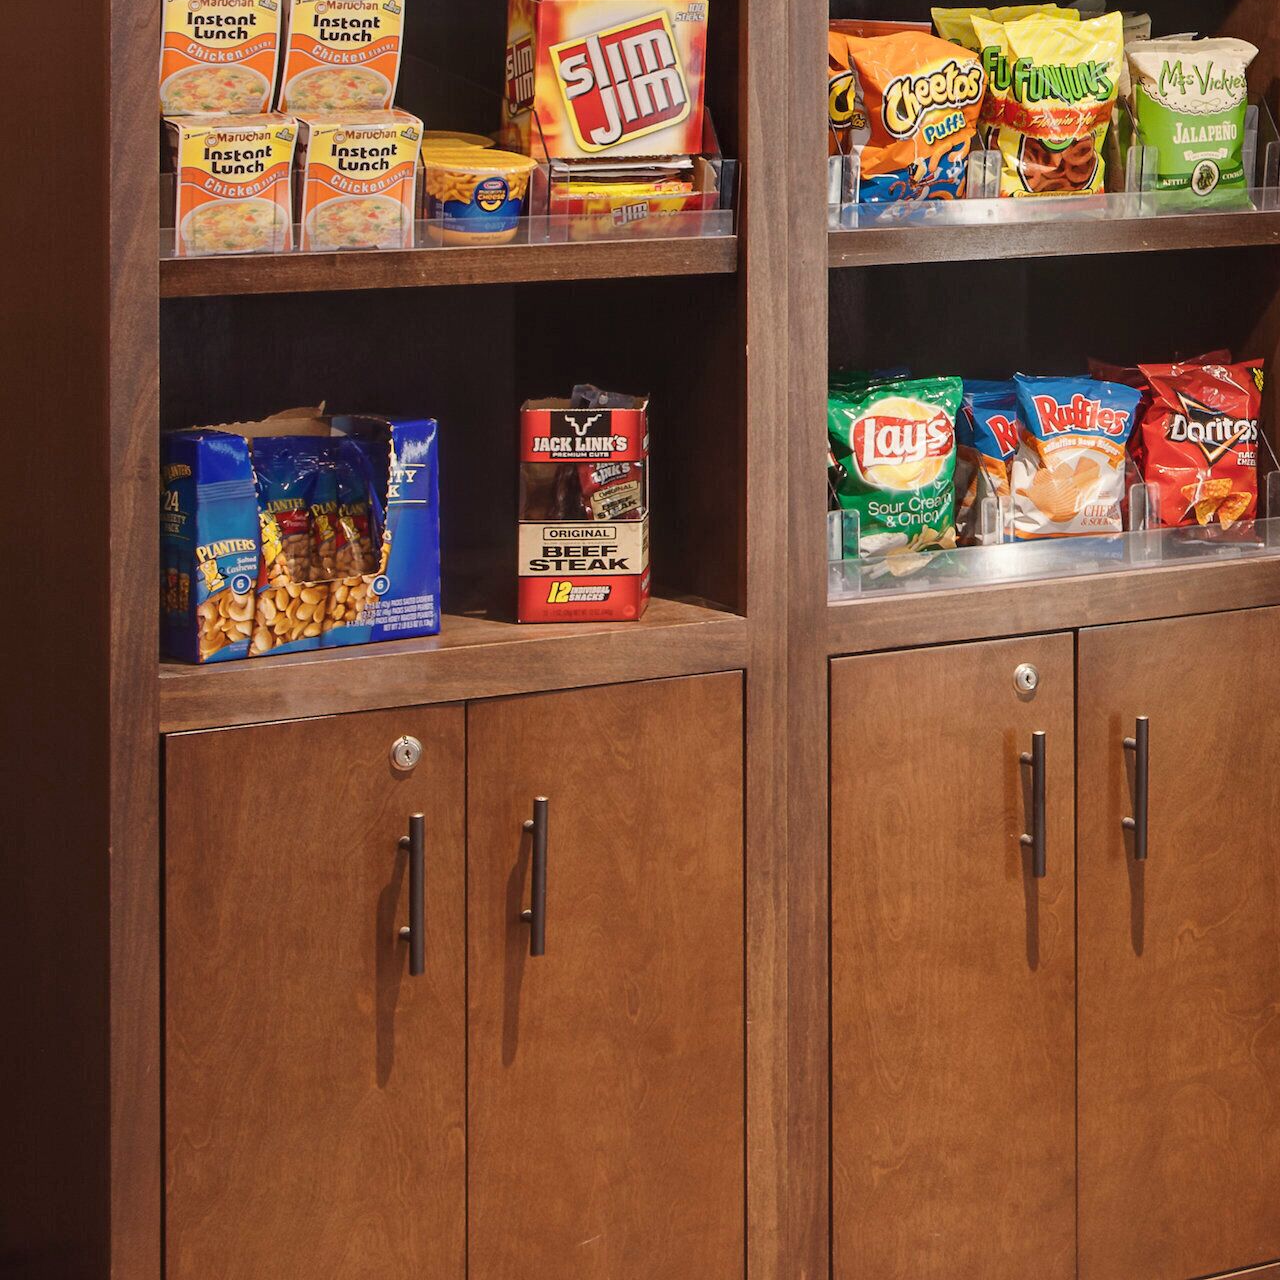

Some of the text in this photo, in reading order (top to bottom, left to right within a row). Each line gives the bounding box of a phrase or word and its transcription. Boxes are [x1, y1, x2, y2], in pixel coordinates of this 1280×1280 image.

[326, 0, 379, 11] Maruchan
[187, 11, 257, 27] Instant
[313, 15, 381, 30] Instant
[675, 11, 705, 22] Sticks
[194, 26, 248, 40] Lunch
[320, 29, 372, 42] Lunch
[186, 40, 243, 63] Chicken
[312, 44, 366, 64] Chicken
[1192, 60, 1247, 98] Vickie's
[884, 61, 983, 135] Cheetos
[345, 130, 397, 140] Maruchan
[923, 111, 966, 144] Puffs
[1173, 120, 1237, 145] JALAPEÑO
[217, 131, 271, 143] Maruchan
[204, 145, 272, 161] Instant
[331, 144, 398, 158] Instant
[211, 161, 265, 175] Lunch
[338, 159, 390, 172] Lunch
[204, 178, 262, 198] Chicken
[330, 173, 384, 194] Chicken
[1032, 393, 1131, 437] Ruffles
[1170, 414, 1258, 443] Doritos
[532, 434, 628, 453] JACK LINK'S
[863, 416, 948, 471] Lay's
[868, 493, 952, 518] Sour Cream
[886, 508, 940, 528] & Onion
[549, 529, 610, 539] ORIGINAL
[196, 539, 257, 562] PLANTERS
[541, 546, 618, 559] BEEF
[236, 556, 257, 566] Salted
[528, 557, 630, 572] STEAK
[226, 563, 258, 576] Cashews
[235, 578, 245, 591] 6
[375, 578, 385, 591] 6
[570, 585, 611, 595] INDIVIDUAL
[546, 581, 573, 604] 12
[569, 593, 606, 603] SNACKS
